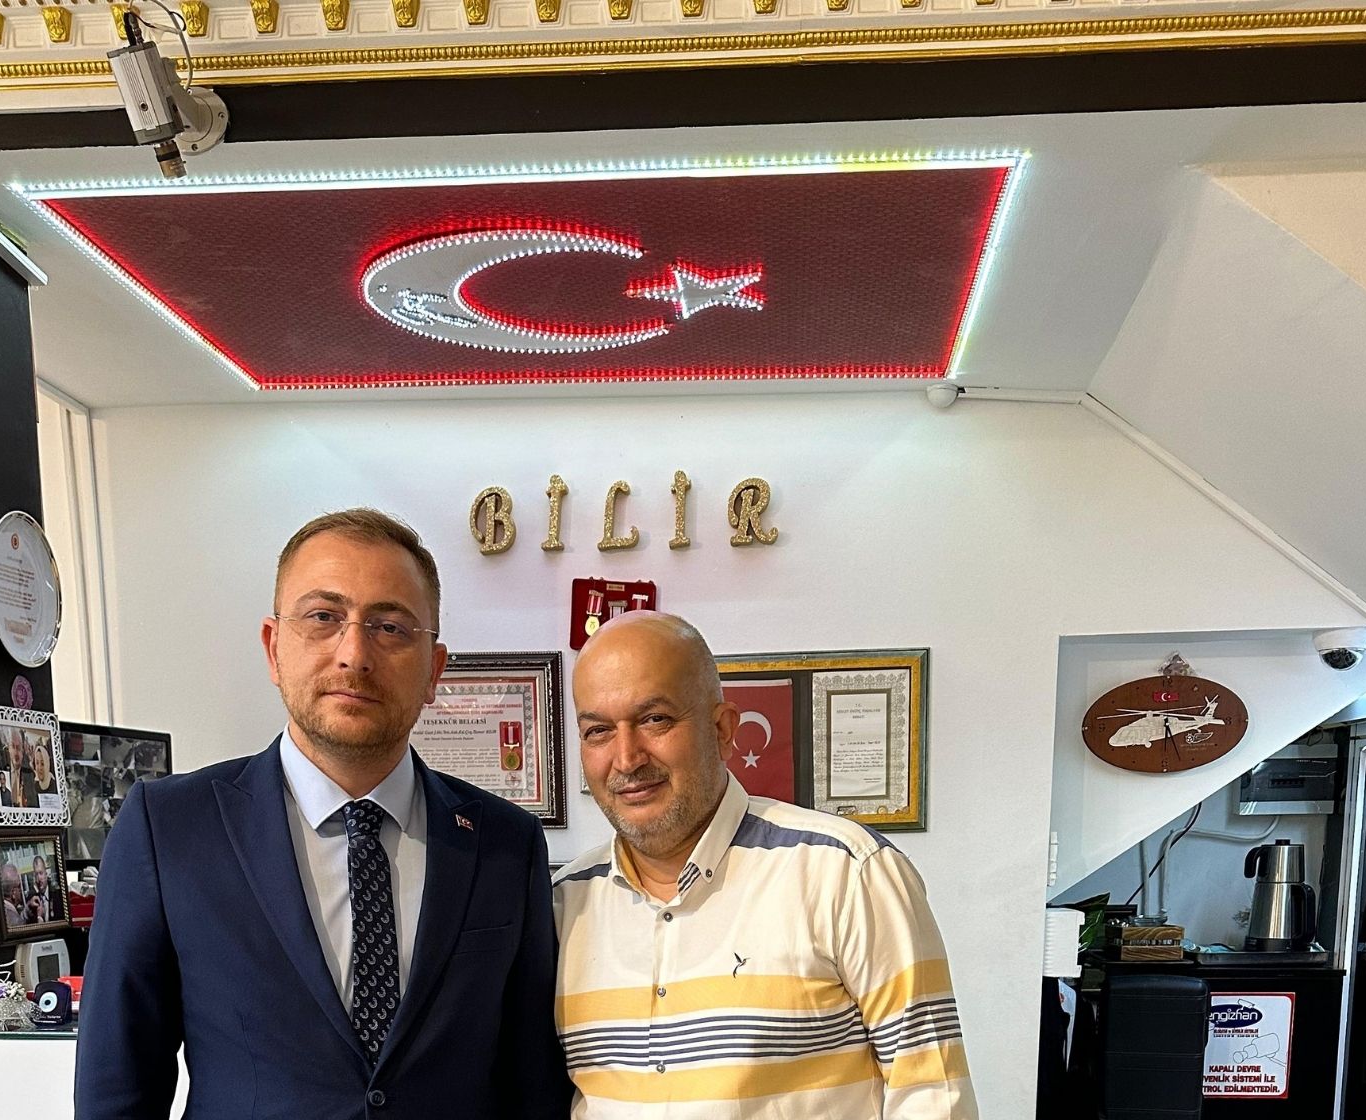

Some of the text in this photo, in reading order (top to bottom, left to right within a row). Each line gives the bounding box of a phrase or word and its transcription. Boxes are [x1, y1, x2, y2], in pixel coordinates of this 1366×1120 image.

[469, 470, 778, 556] BİLİR
[1203, 1074, 1276, 1083] VENLİK SİSTEMİ İLE
